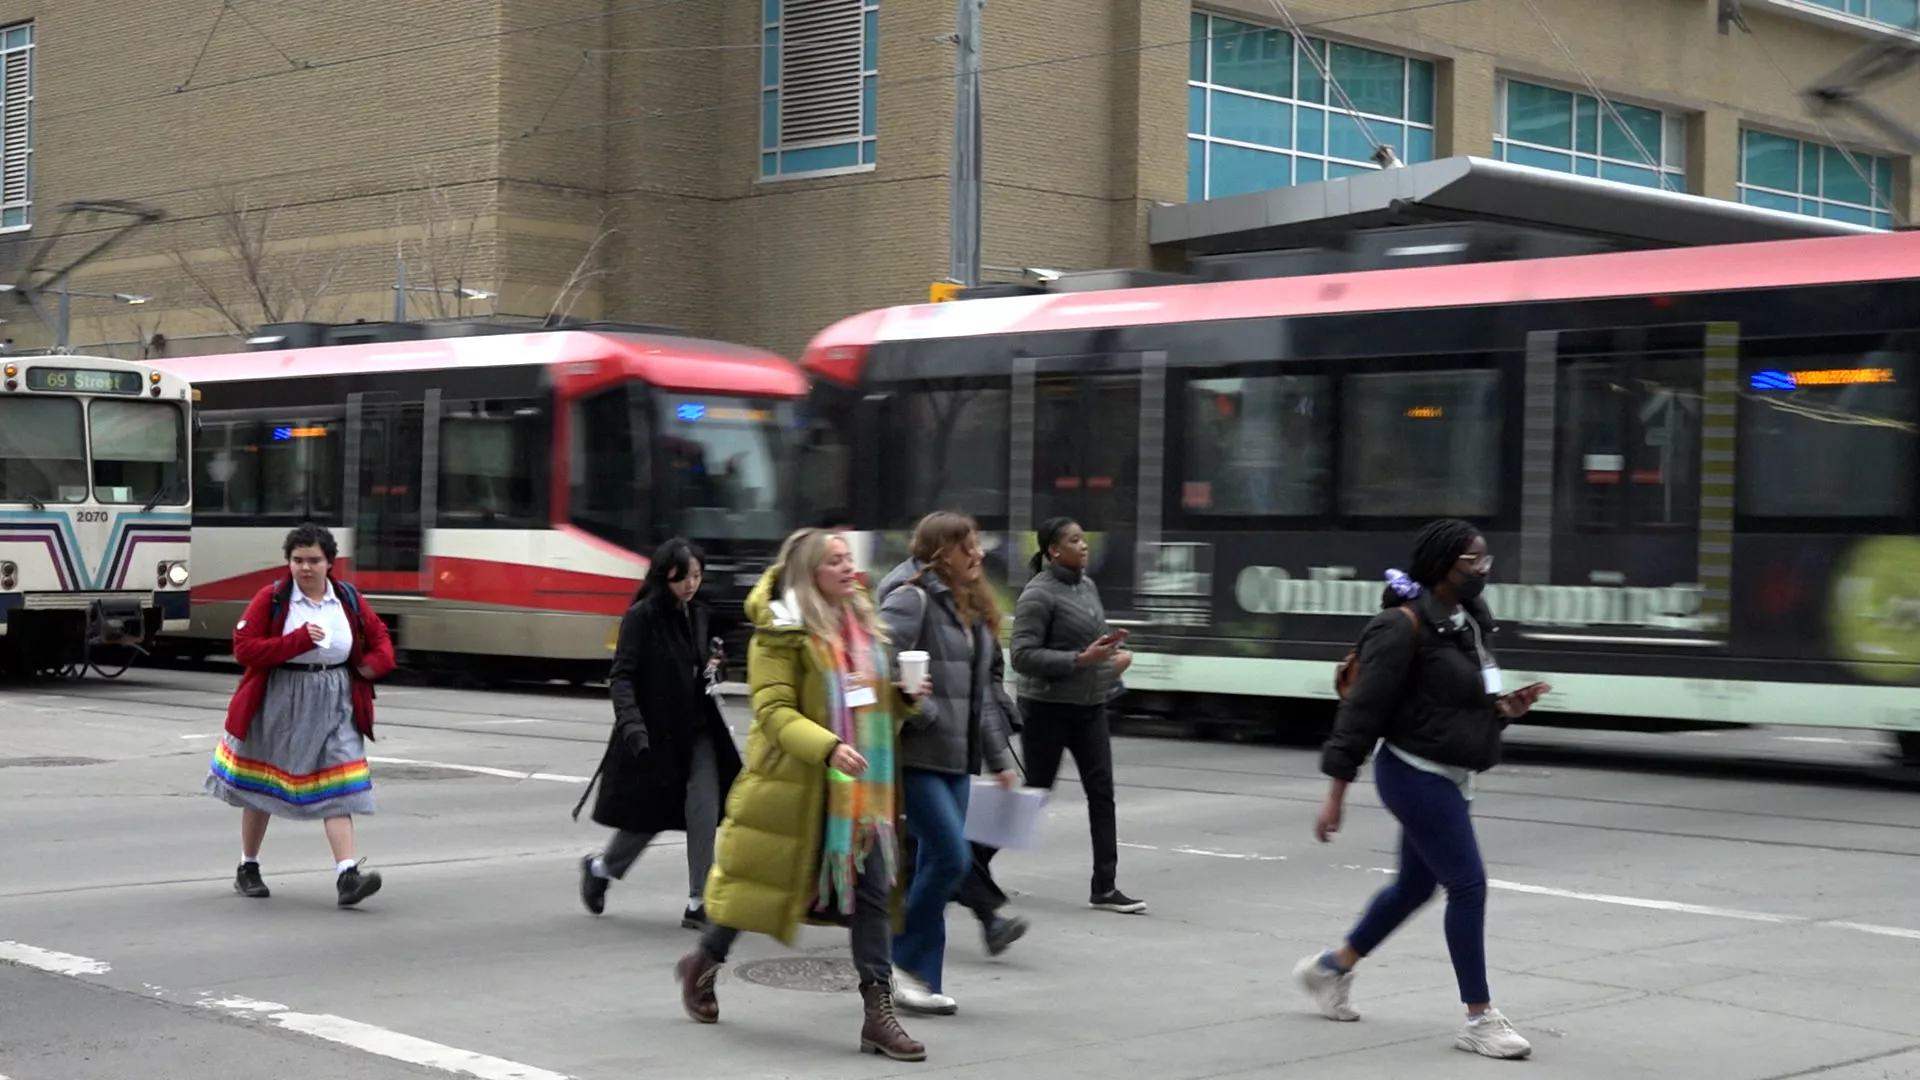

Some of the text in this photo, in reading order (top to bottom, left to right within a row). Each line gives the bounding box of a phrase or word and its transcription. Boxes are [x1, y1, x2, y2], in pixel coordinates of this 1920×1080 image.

[47, 373, 119, 391] 69 Street
[76, 511, 109, 522] 2070
